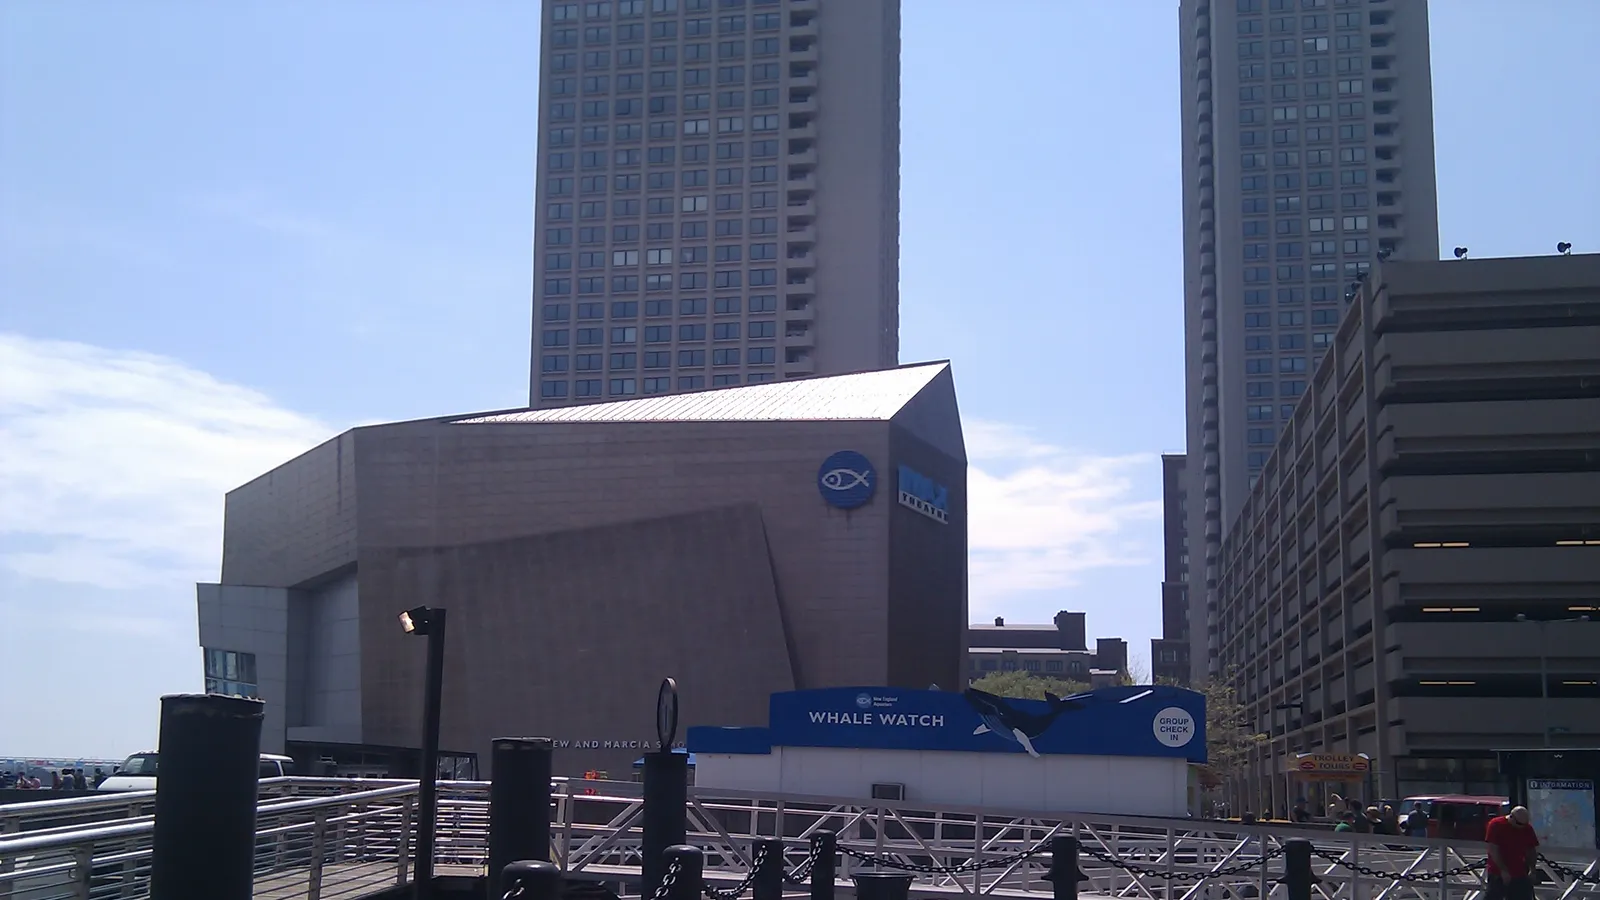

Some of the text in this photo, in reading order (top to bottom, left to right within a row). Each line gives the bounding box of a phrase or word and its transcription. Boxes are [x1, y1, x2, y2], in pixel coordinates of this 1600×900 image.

[902, 492, 947, 521] THEATRE
[809, 711, 944, 727] WHALE WATCH
[574, 740, 599, 749] AND
[604, 740, 651, 749] MARCIA
[1540, 781, 1590, 789] INFORMATION
